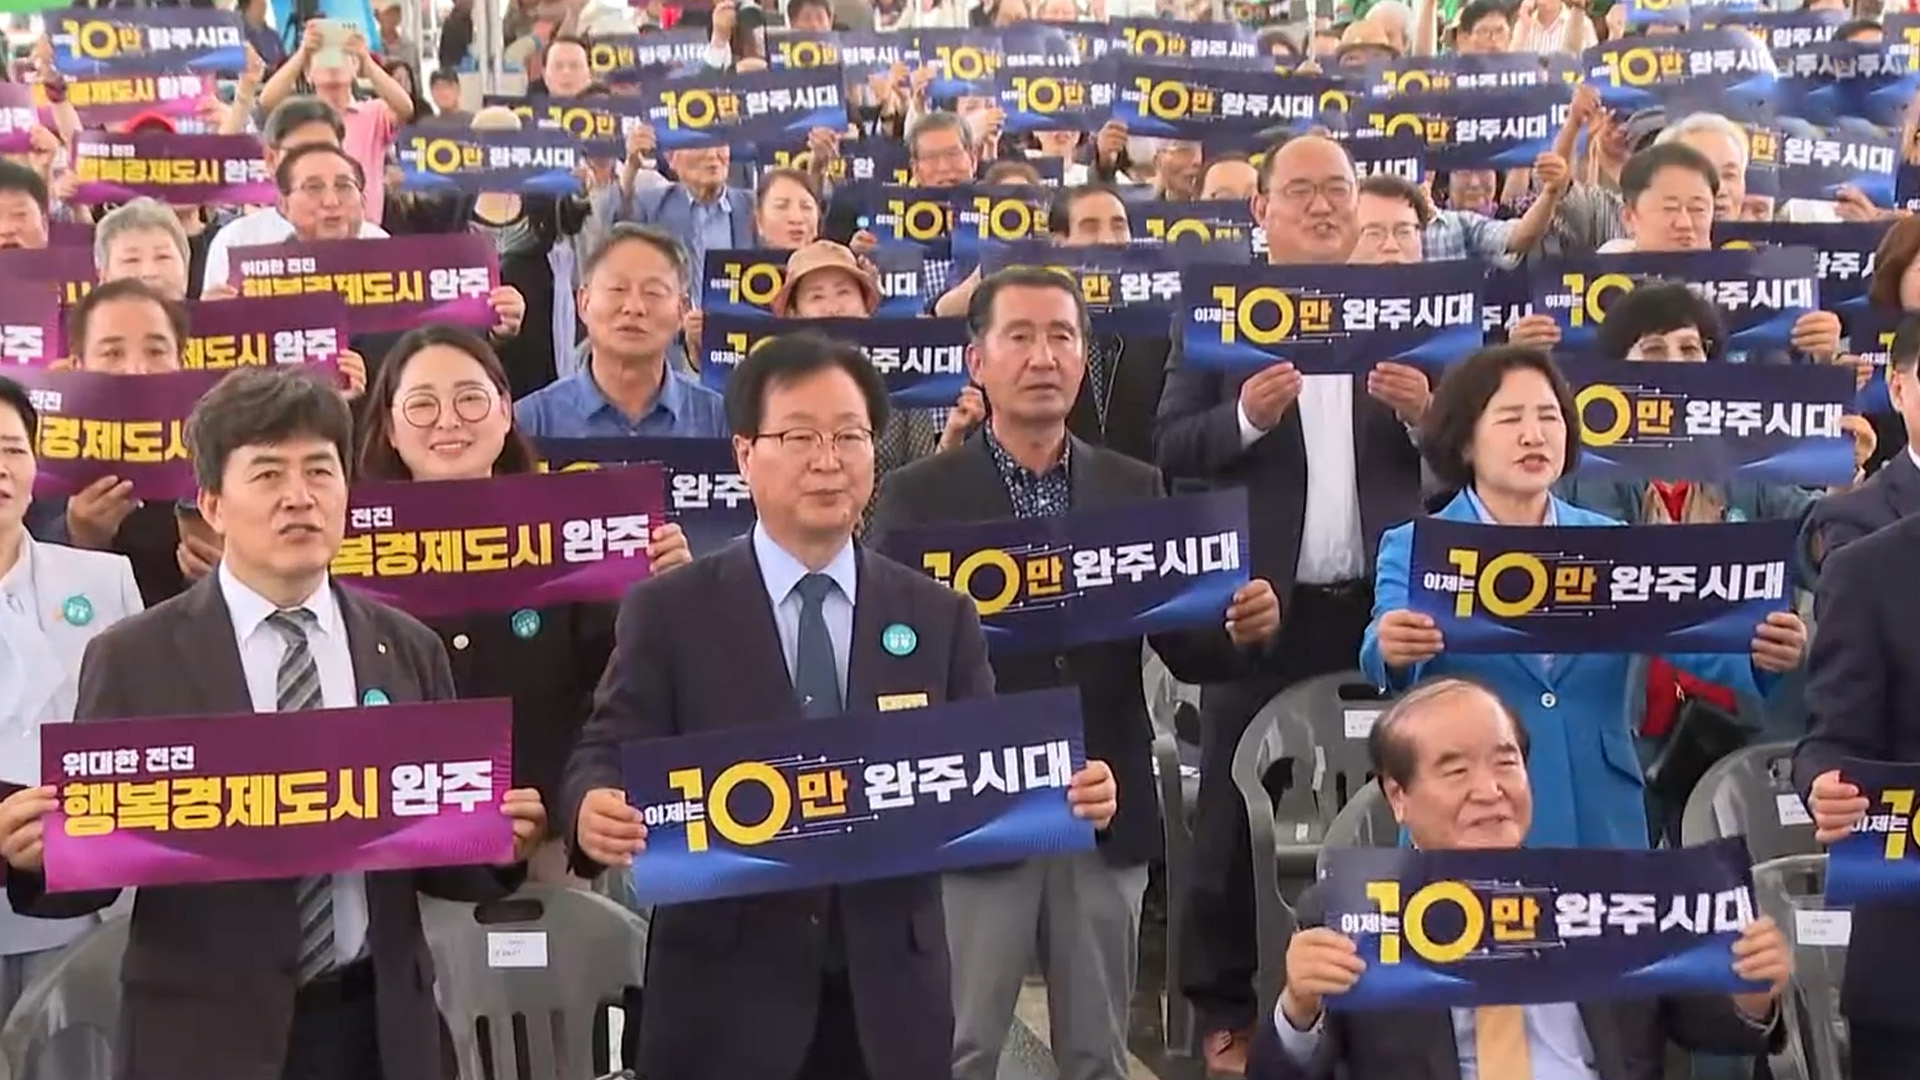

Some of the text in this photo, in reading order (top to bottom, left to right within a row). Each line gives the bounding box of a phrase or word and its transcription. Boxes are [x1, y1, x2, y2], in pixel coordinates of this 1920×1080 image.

[660, 89, 740, 130] 10만
[745, 84, 840, 115] 완주시대
[1135, 77, 1214, 120] 10만
[1221, 92, 1314, 118] 완주시대
[1456, 114, 1547, 145] 완주시대
[411, 137, 483, 174] 10만
[489, 147, 576, 168] 완주시대
[1784, 138, 1895, 174] 완주시대
[429, 266, 490, 300] 완주
[1212, 285, 1332, 345] 10만
[1342, 292, 1474, 332] 완주시대
[273, 327, 338, 364] 완주
[859, 344, 964, 375] 주시대
[1684, 400, 1843, 438] 완주시대
[350, 506, 394, 528] 전진
[562, 514, 650, 562] 완주
[1072, 531, 1240, 588] 완주시대
[1422, 548, 1786, 619] 이제는 10만 완주시대
[62, 745, 195, 777] 위대한 전진
[62, 759, 494, 838] 행복경제도시 완주
[644, 739, 1074, 853] 이제는 10만 완주시대
[1340, 879, 1756, 964] 이제는 10만 완주시대
